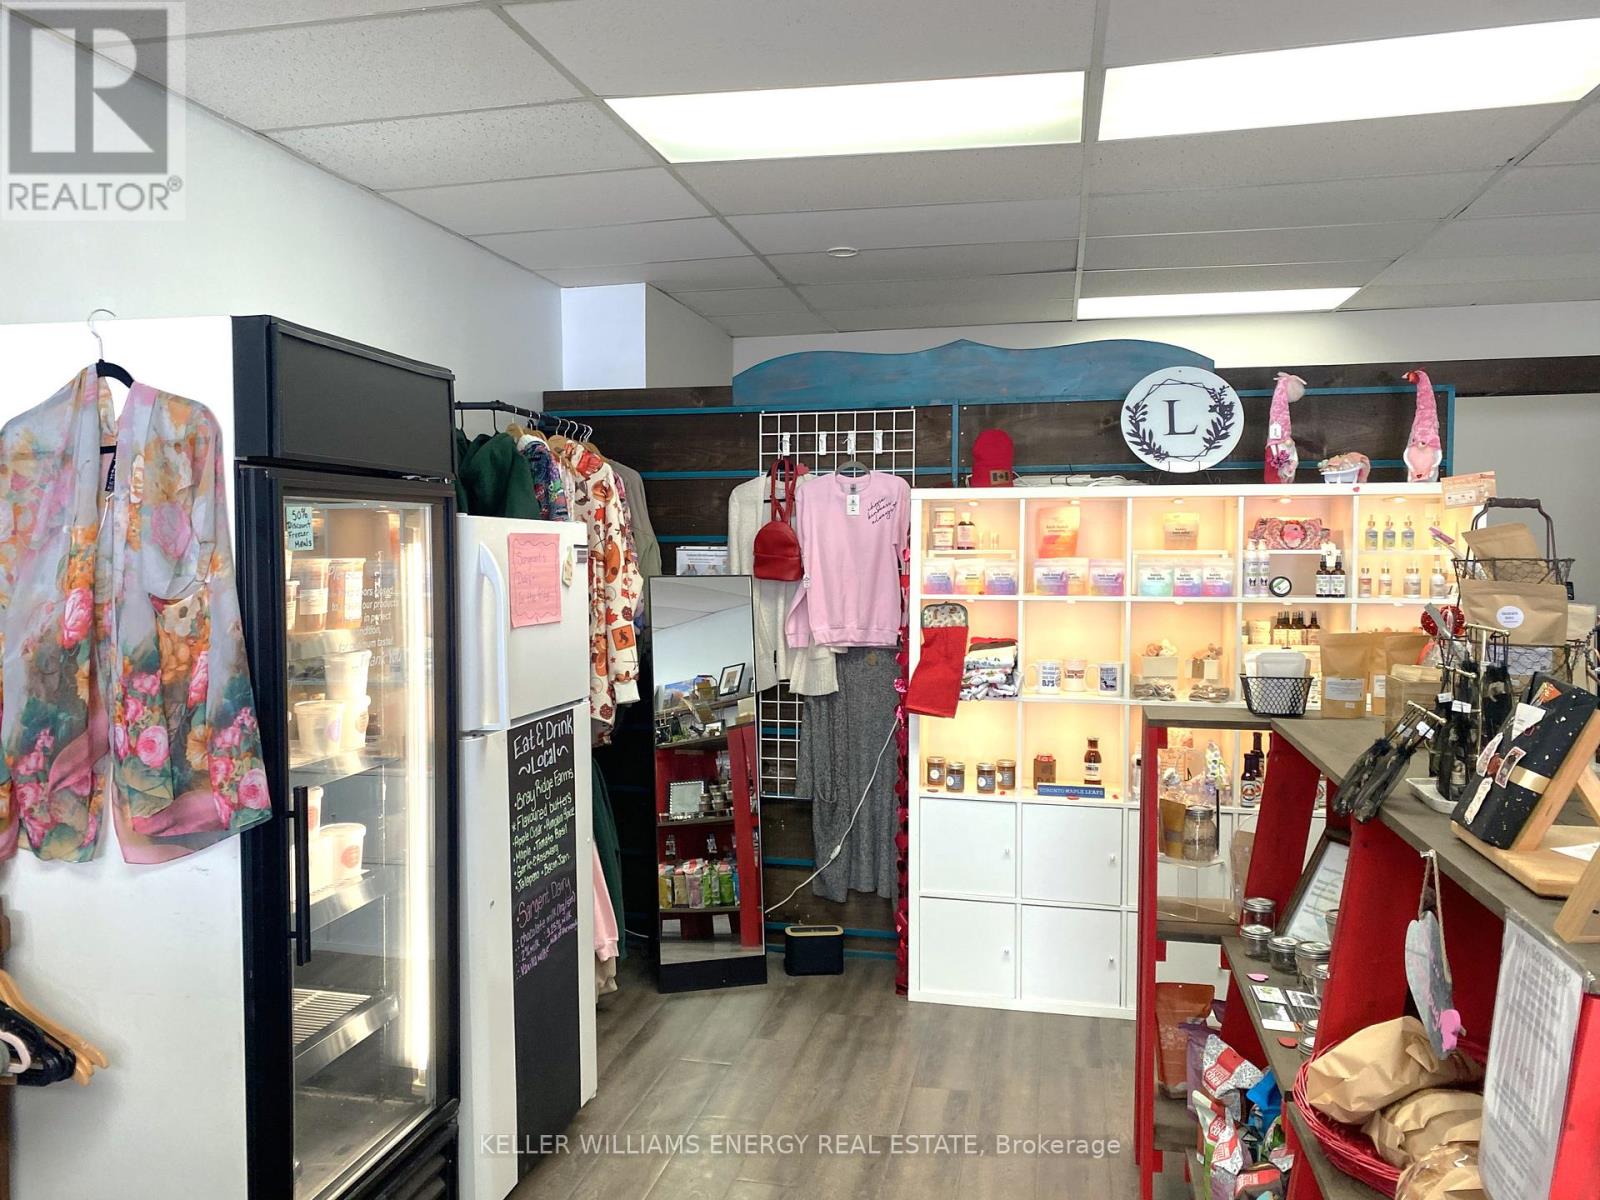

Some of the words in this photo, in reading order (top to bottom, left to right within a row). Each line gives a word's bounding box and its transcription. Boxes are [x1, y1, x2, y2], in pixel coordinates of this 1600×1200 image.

[1162, 399, 1198, 436] L
[287, 520, 311, 530] Discount
[292, 508, 308, 521] 50%
[513, 732, 536, 760] Eat
[546, 714, 574, 741] Drink
[531, 742, 557, 775] Local
[516, 787, 537, 812] Bray
[535, 776, 555, 800] Ridge
[553, 768, 574, 786] Farms
[516, 807, 548, 832] Flavoured
[549, 791, 573, 814] butters
[551, 877, 572, 898] Dairy
